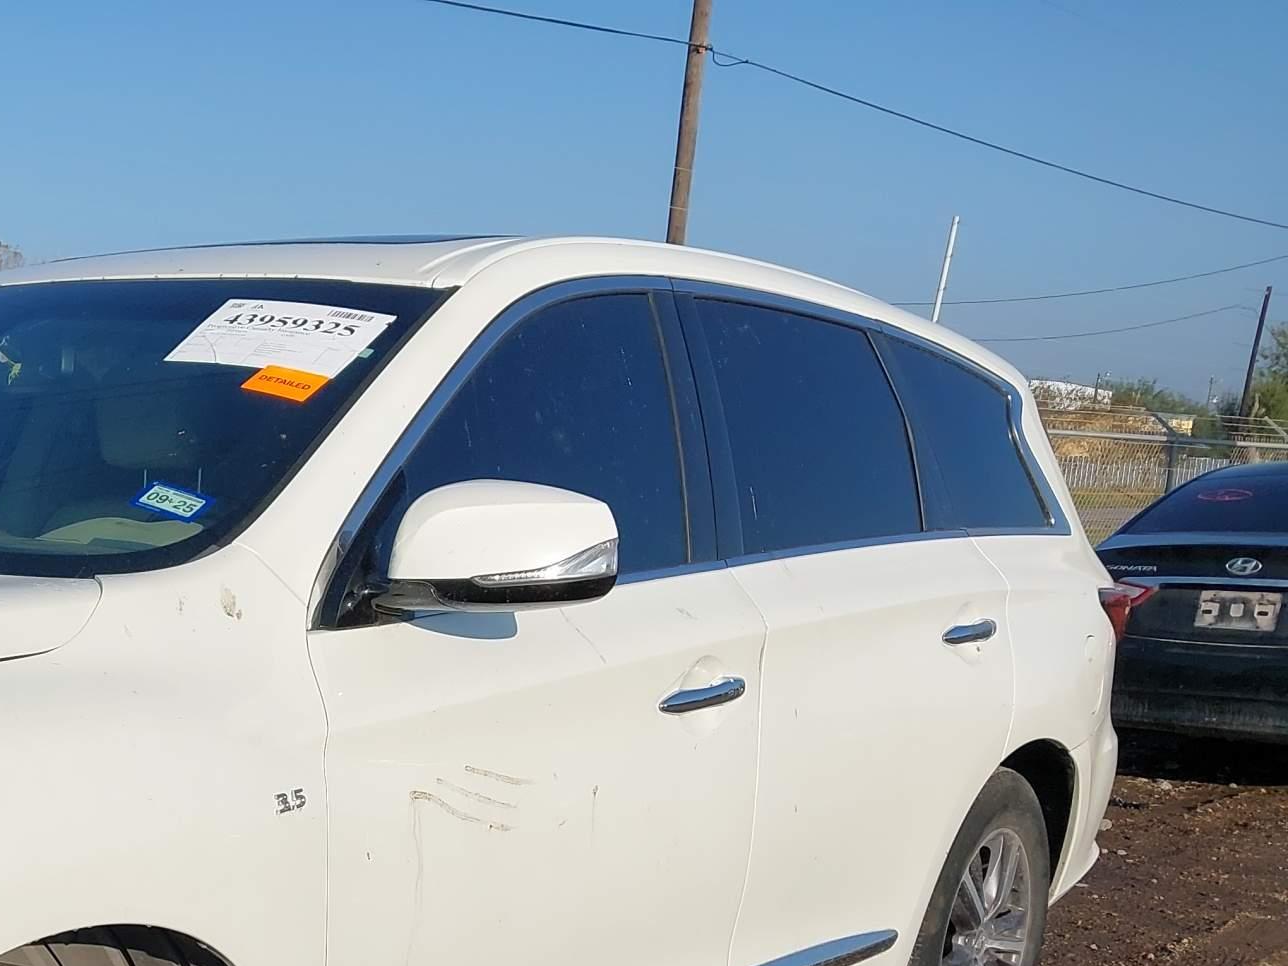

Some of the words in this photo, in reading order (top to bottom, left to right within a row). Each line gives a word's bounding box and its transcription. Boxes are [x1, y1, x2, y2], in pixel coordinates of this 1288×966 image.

[223, 313, 361, 337] 43959325
[258, 374, 312, 390] DETAILED
[146, 492, 169, 504] 09
[172, 501, 198, 513] 25
